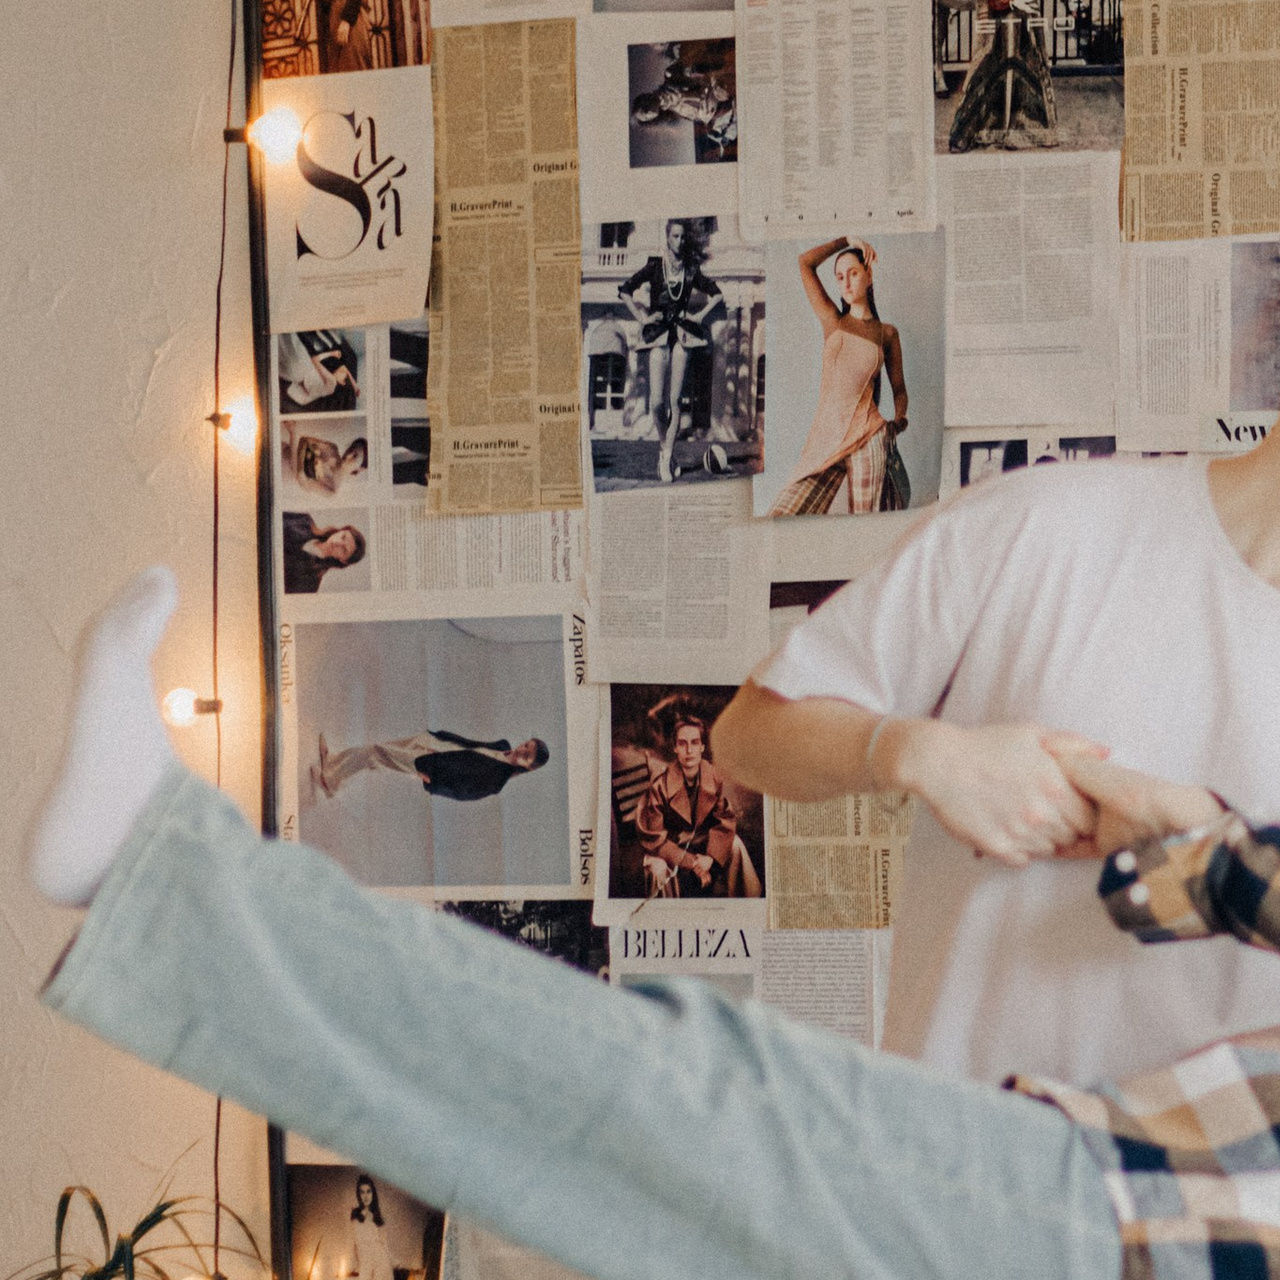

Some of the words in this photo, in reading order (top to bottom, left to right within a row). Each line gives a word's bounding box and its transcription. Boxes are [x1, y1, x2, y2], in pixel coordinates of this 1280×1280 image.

[1150, 3, 1161, 56] Collection
[578, 828, 594, 886] Bolsos
[624, 929, 752, 958] BELLEZA
